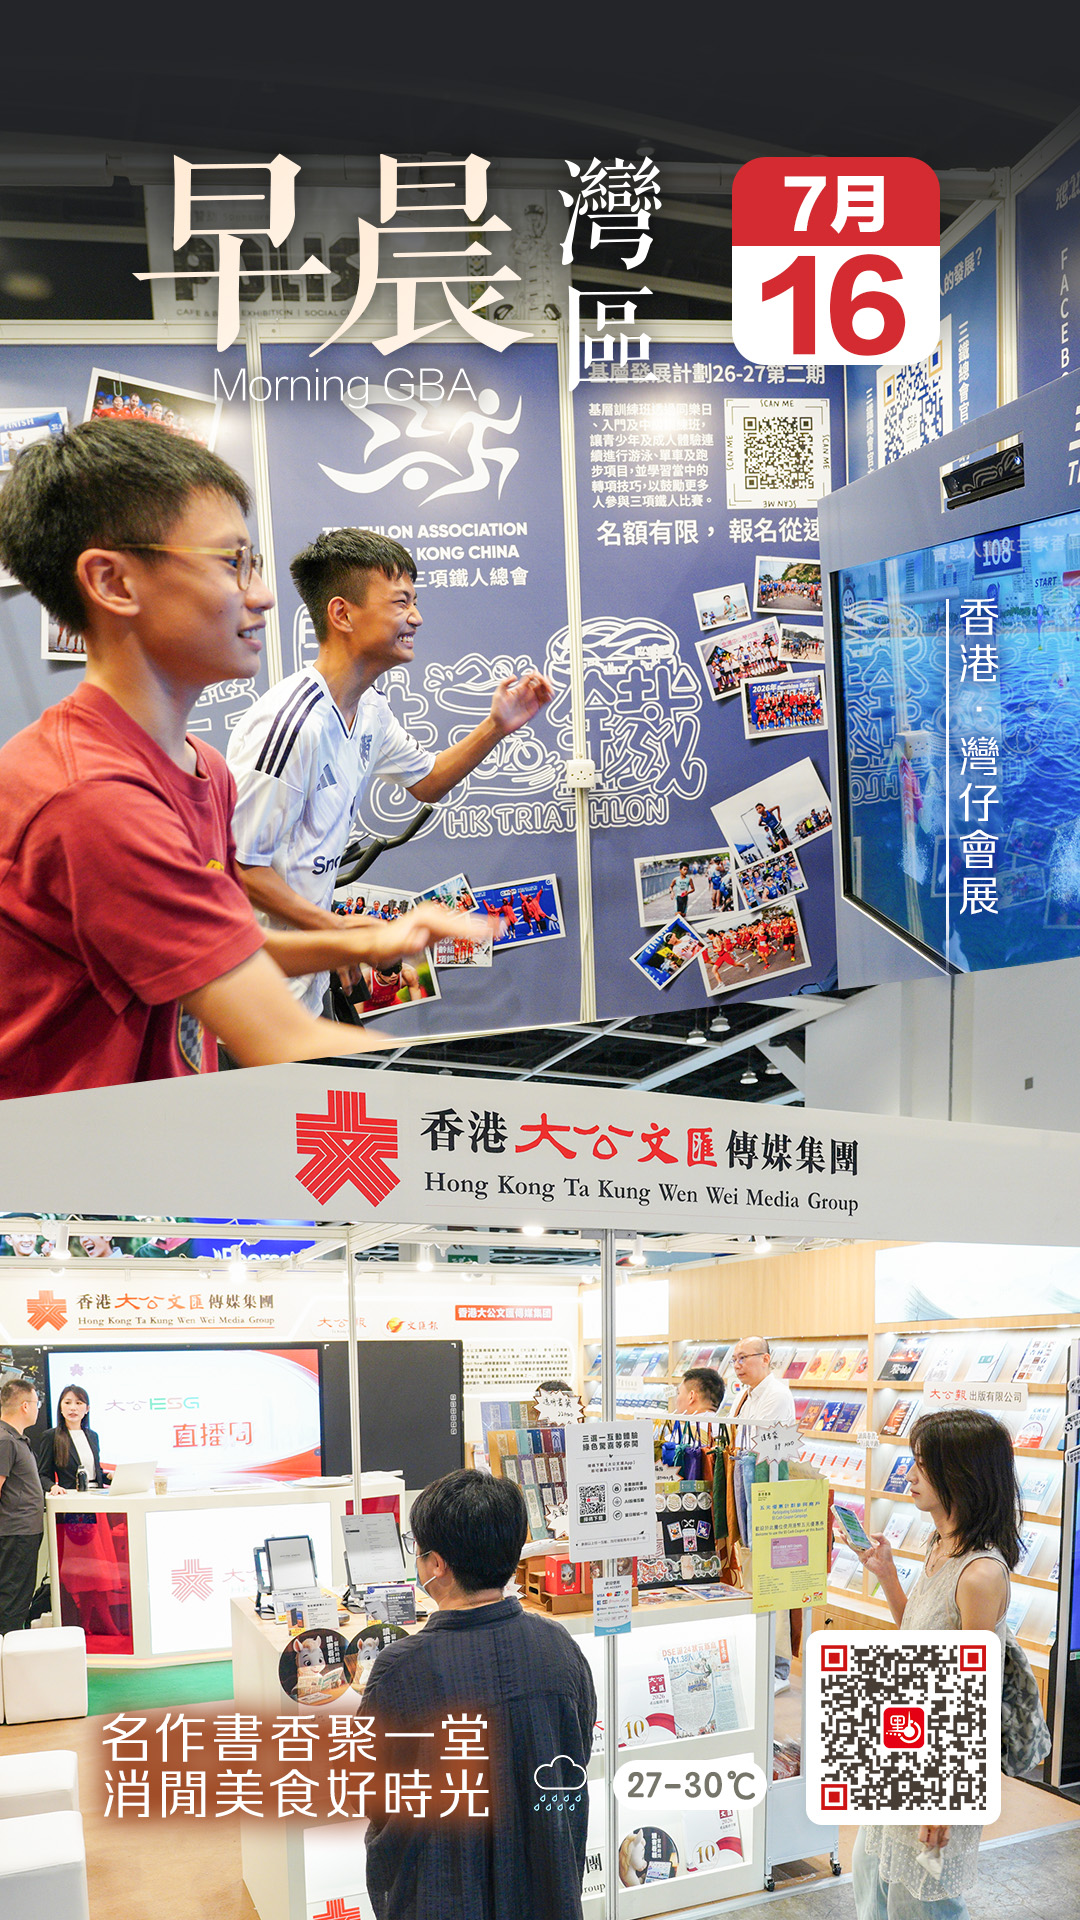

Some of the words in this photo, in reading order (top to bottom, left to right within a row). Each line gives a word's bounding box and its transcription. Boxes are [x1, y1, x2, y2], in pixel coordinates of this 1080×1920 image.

[304, 309, 338, 317] SOCIAL
[1060, 247, 1070, 376] FACEB
[958, 320, 970, 425] 三鐵總會官
[760, 400, 779, 408] SCAN
[782, 400, 794, 408] ME
[4, 417, 35, 430] FINISH
[726, 435, 734, 448] ME
[822, 435, 830, 453] SCAN
[726, 451, 734, 471] SCAN
[823, 456, 830, 470] ME
[763, 500, 775, 508] ME
[778, 500, 797, 508] SCAN
[417, 522, 528, 538] ASSOCIATION
[416, 547, 464, 561] KONG
[468, 545, 520, 558] CHINA
[983, 536, 1011, 566] 108
[1034, 576, 1058, 587] START
[449, 809, 491, 836] HK
[496, 800, 666, 831] TRIATHLON
[420, 1107, 859, 1176] 香港大公文匯傳媒集團
[424, 1171, 489, 1200] Hong
[498, 1174, 556, 1203] Kong
[563, 1177, 590, 1197] Ta
[598, 1179, 651, 1206] Kung
[658, 1183, 698, 1203] Wen
[706, 1186, 739, 1205] Wei
[746, 1188, 800, 1208] Media
[808, 1191, 859, 1216] Group
[77, 1292, 274, 1310] 香港大公文匯傳媒集團
[78, 1316, 105, 1326] Hong
[107, 1316, 132, 1326] Kong
[136, 1316, 147, 1325] Ta
[150, 1316, 174, 1326] Kung
[177, 1316, 196, 1324] Wen
[199, 1315, 216, 1324] Wei
[219, 1315, 245, 1324] Media
[248, 1315, 275, 1326] Group
[458, 1306, 551, 1319] 香港大公文匯傳媒集團
[929, 1388, 968, 1402] 大公報
[969, 1391, 1022, 1403] 出版有限公司
[624, 1719, 645, 1740] 10
[697, 1844, 715, 1864] 10
[584, 1882, 606, 1894] roup
